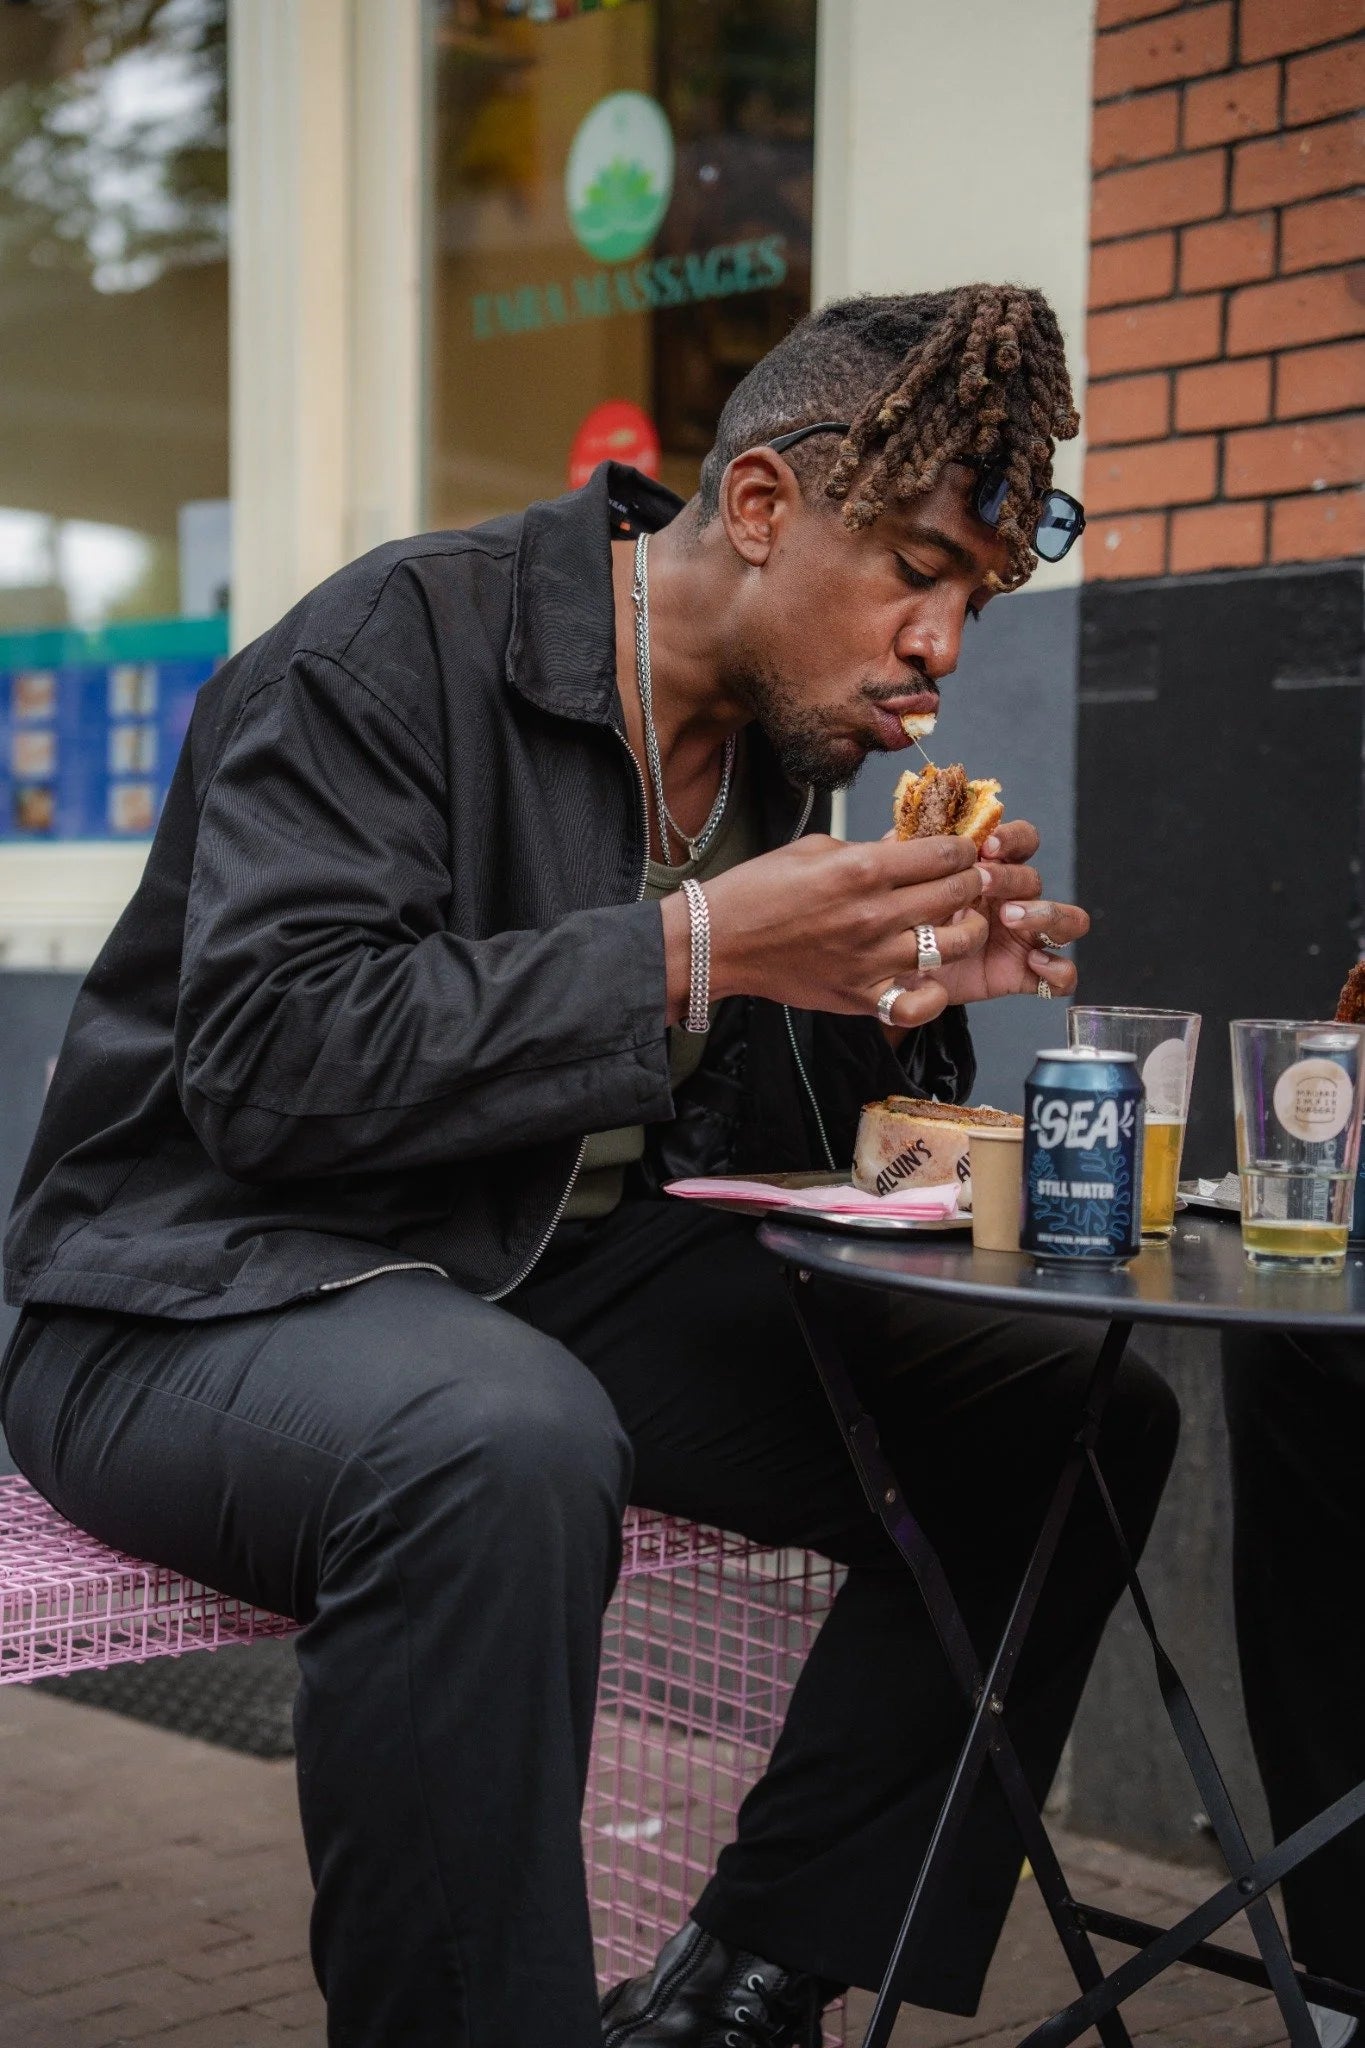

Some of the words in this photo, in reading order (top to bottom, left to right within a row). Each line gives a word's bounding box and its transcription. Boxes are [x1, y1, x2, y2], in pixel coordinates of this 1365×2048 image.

[572, 234, 787, 317] MASSAGES
[1037, 1099, 1119, 1150] SEA
[876, 1138, 932, 1196] ALVIN'S
[1037, 1180, 1069, 1198] STILL
[1070, 1182, 1115, 1200] WATER
